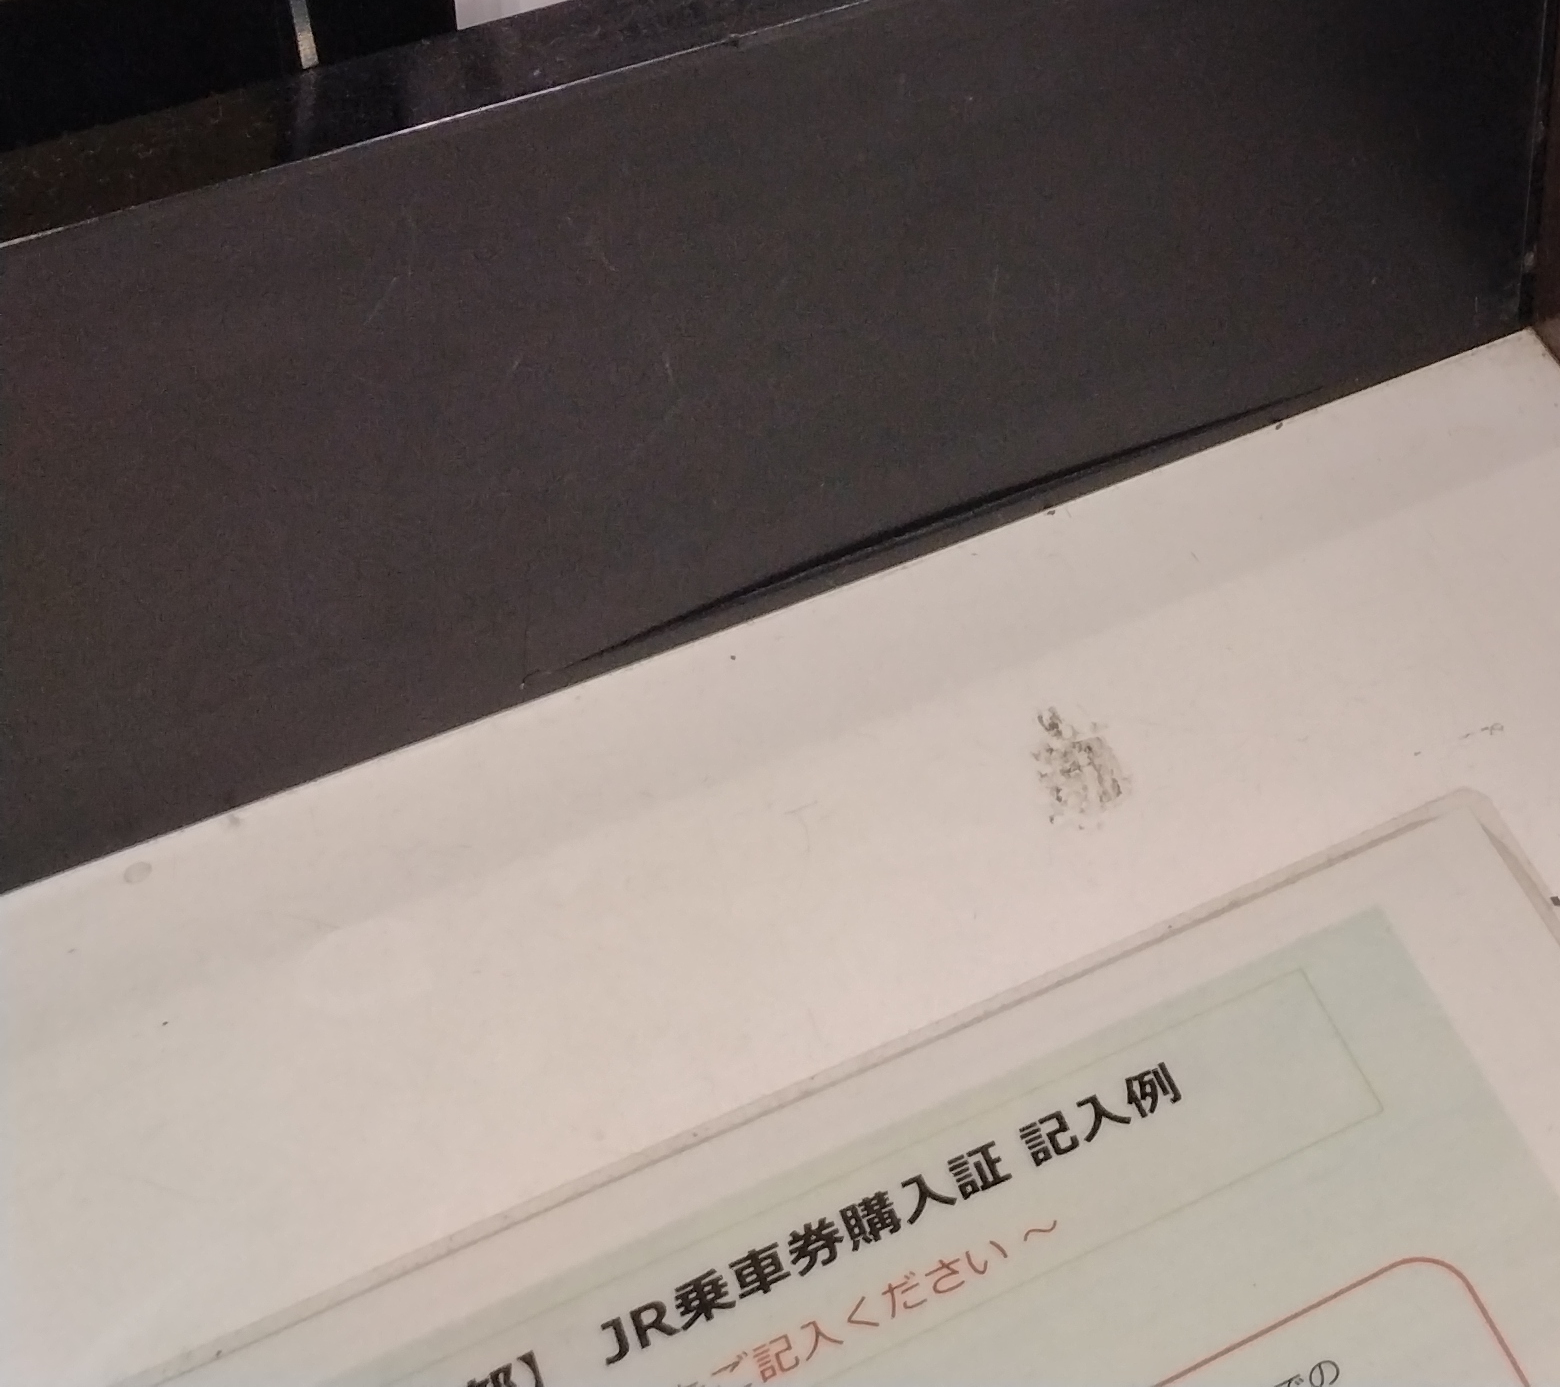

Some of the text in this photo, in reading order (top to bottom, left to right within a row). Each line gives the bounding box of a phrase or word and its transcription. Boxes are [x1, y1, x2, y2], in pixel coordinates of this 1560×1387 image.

[599, 1060, 1183, 1367] JR乗車券購入証 記入例
